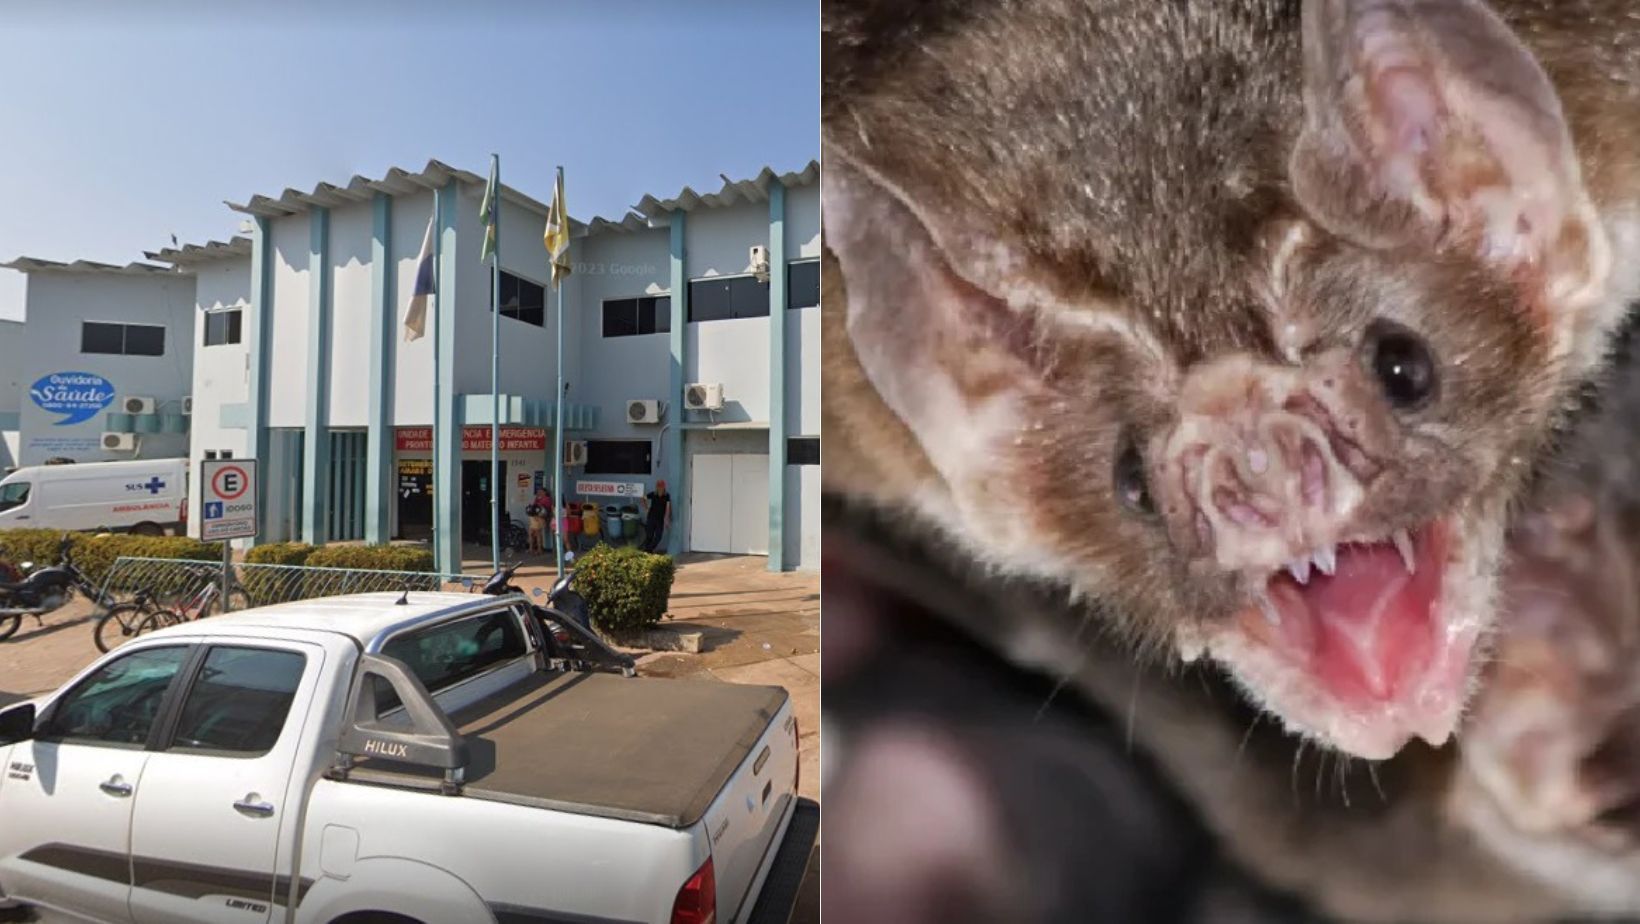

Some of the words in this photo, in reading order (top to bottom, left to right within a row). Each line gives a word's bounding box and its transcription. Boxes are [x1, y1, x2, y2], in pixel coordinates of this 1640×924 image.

[50, 374, 103, 386] Ouvidoria
[397, 430, 427, 439] UNIDADE
[507, 440, 540, 449] INFANTIL
[125, 483, 144, 491] SUS
[224, 474, 238, 492] E
[226, 503, 253, 513] IDOSO
[364, 740, 408, 757] HILUX
[225, 898, 268, 914] LIMITED
